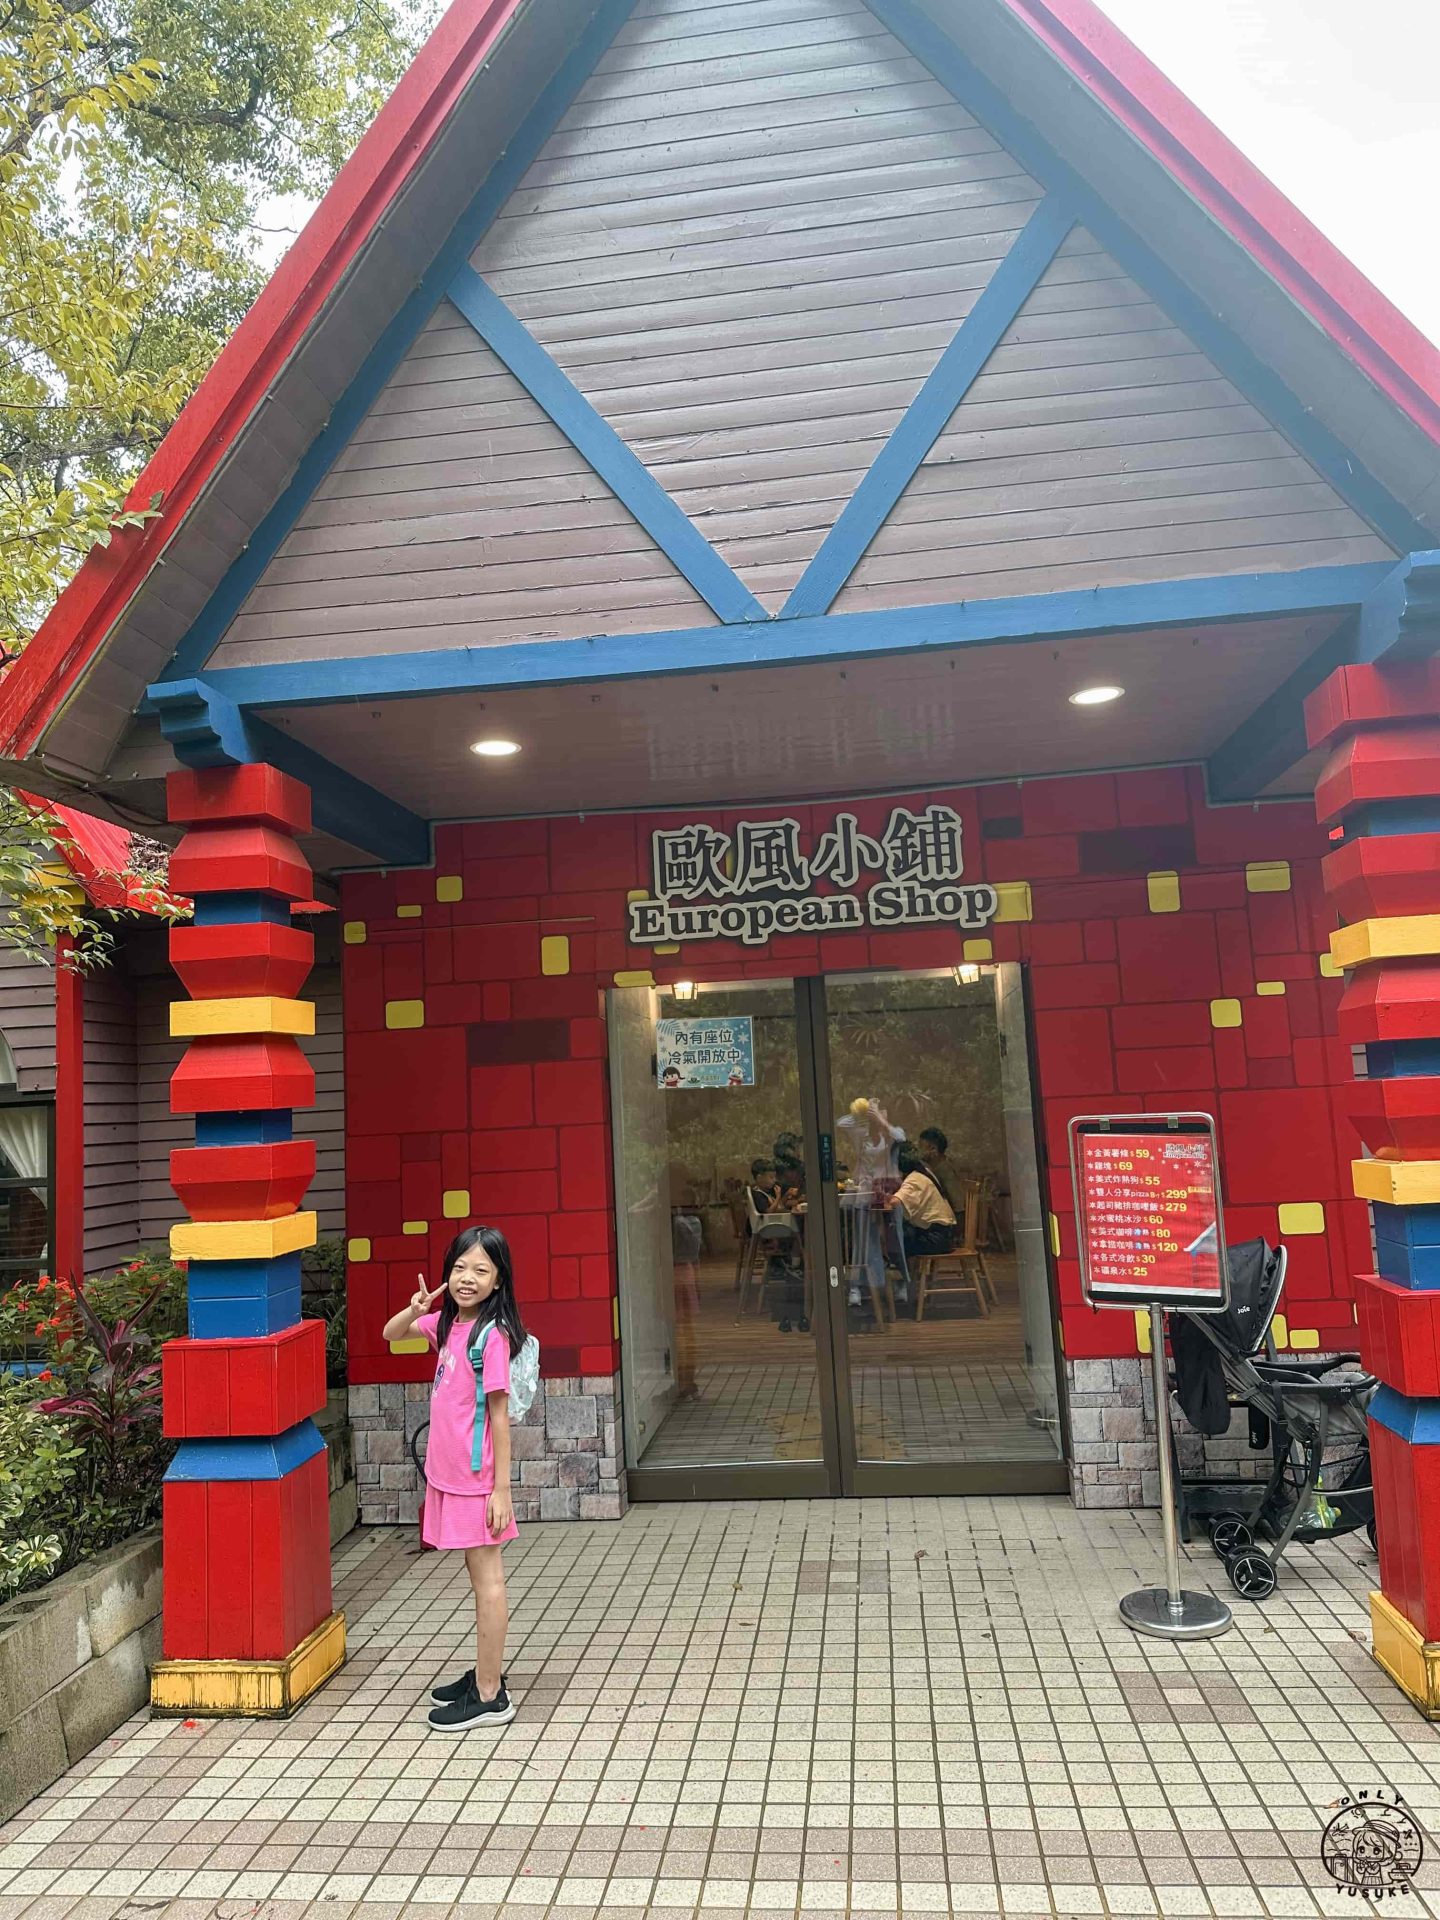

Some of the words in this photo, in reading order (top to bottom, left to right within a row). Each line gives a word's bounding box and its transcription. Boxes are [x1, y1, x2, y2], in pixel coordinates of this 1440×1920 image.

[654, 807, 962, 897] 歐風小鋪
[632, 895, 859, 940] European
[872, 884, 993, 924] Shop
[675, 1029, 734, 1045] 內有座位
[668, 1047, 740, 1066] 冷氣開放中
